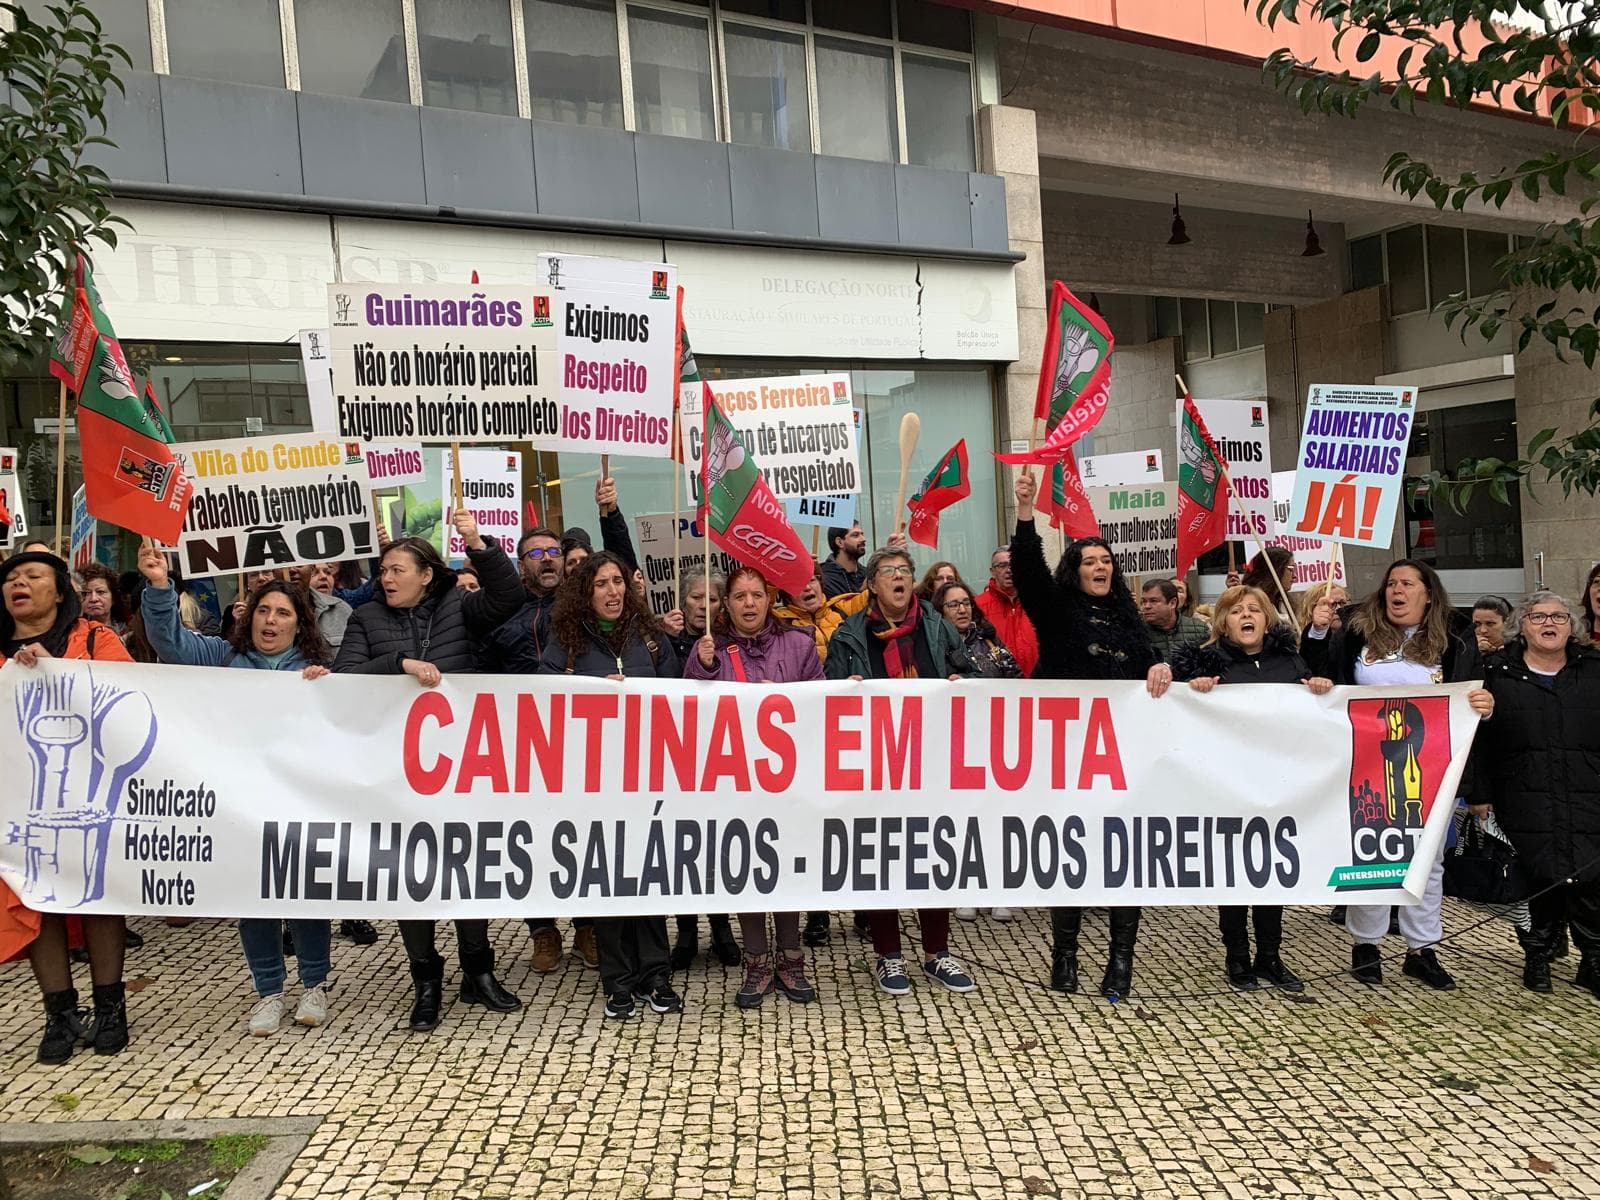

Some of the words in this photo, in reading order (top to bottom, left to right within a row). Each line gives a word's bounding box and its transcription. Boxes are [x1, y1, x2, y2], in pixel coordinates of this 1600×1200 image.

[762, 277, 862, 298] DELEGAÇÃO
[365, 292, 523, 327] Guimarães
[566, 302, 649, 343] Exigimos
[353, 342, 386, 387] Não
[390, 352, 411, 387] ao
[414, 343, 477, 387] horário
[480, 345, 538, 390] parcial
[563, 353, 648, 393] Respeito
[760, 383, 831, 410] Ferreira
[337, 395, 414, 441] Exigimos
[416, 393, 478, 437] horário
[482, 397, 558, 439] completo
[595, 406, 669, 446] Direitos
[1306, 408, 1409, 441] AUMENTOS
[757, 421, 777, 456] de
[778, 420, 849, 456] Encargos
[192, 447, 237, 478] Vila
[241, 446, 269, 474] do
[272, 440, 341, 472] Conde
[366, 448, 422, 479] Direitos
[774, 457, 856, 496] respeitado
[1303, 441, 1401, 476] SALARIAIS
[261, 473, 367, 525] temporário,
[799, 498, 808, 515] A
[811, 500, 835, 518] LEI!
[1108, 489, 1166, 511] Maia
[1296, 474, 1383, 541] JÁ!
[186, 522, 373, 575] NÃO!
[732, 524, 798, 561] CGTP
[1120, 516, 1159, 543] melhores
[1138, 546, 1169, 572] direitos
[403, 691, 797, 795] CANTINAS
[824, 695, 923, 791] EM
[949, 696, 1128, 791] LUTA
[126, 777, 216, 820] Sindicato
[125, 825, 213, 863] Hotelaria
[261, 820, 534, 902] MELHORES
[549, 800, 780, 900] SALÁRIOS
[822, 816, 988, 893] DEFESA
[1003, 815, 1088, 890] DOS
[1103, 815, 1300, 889] DIREITOS
[141, 869, 196, 906] Norte
